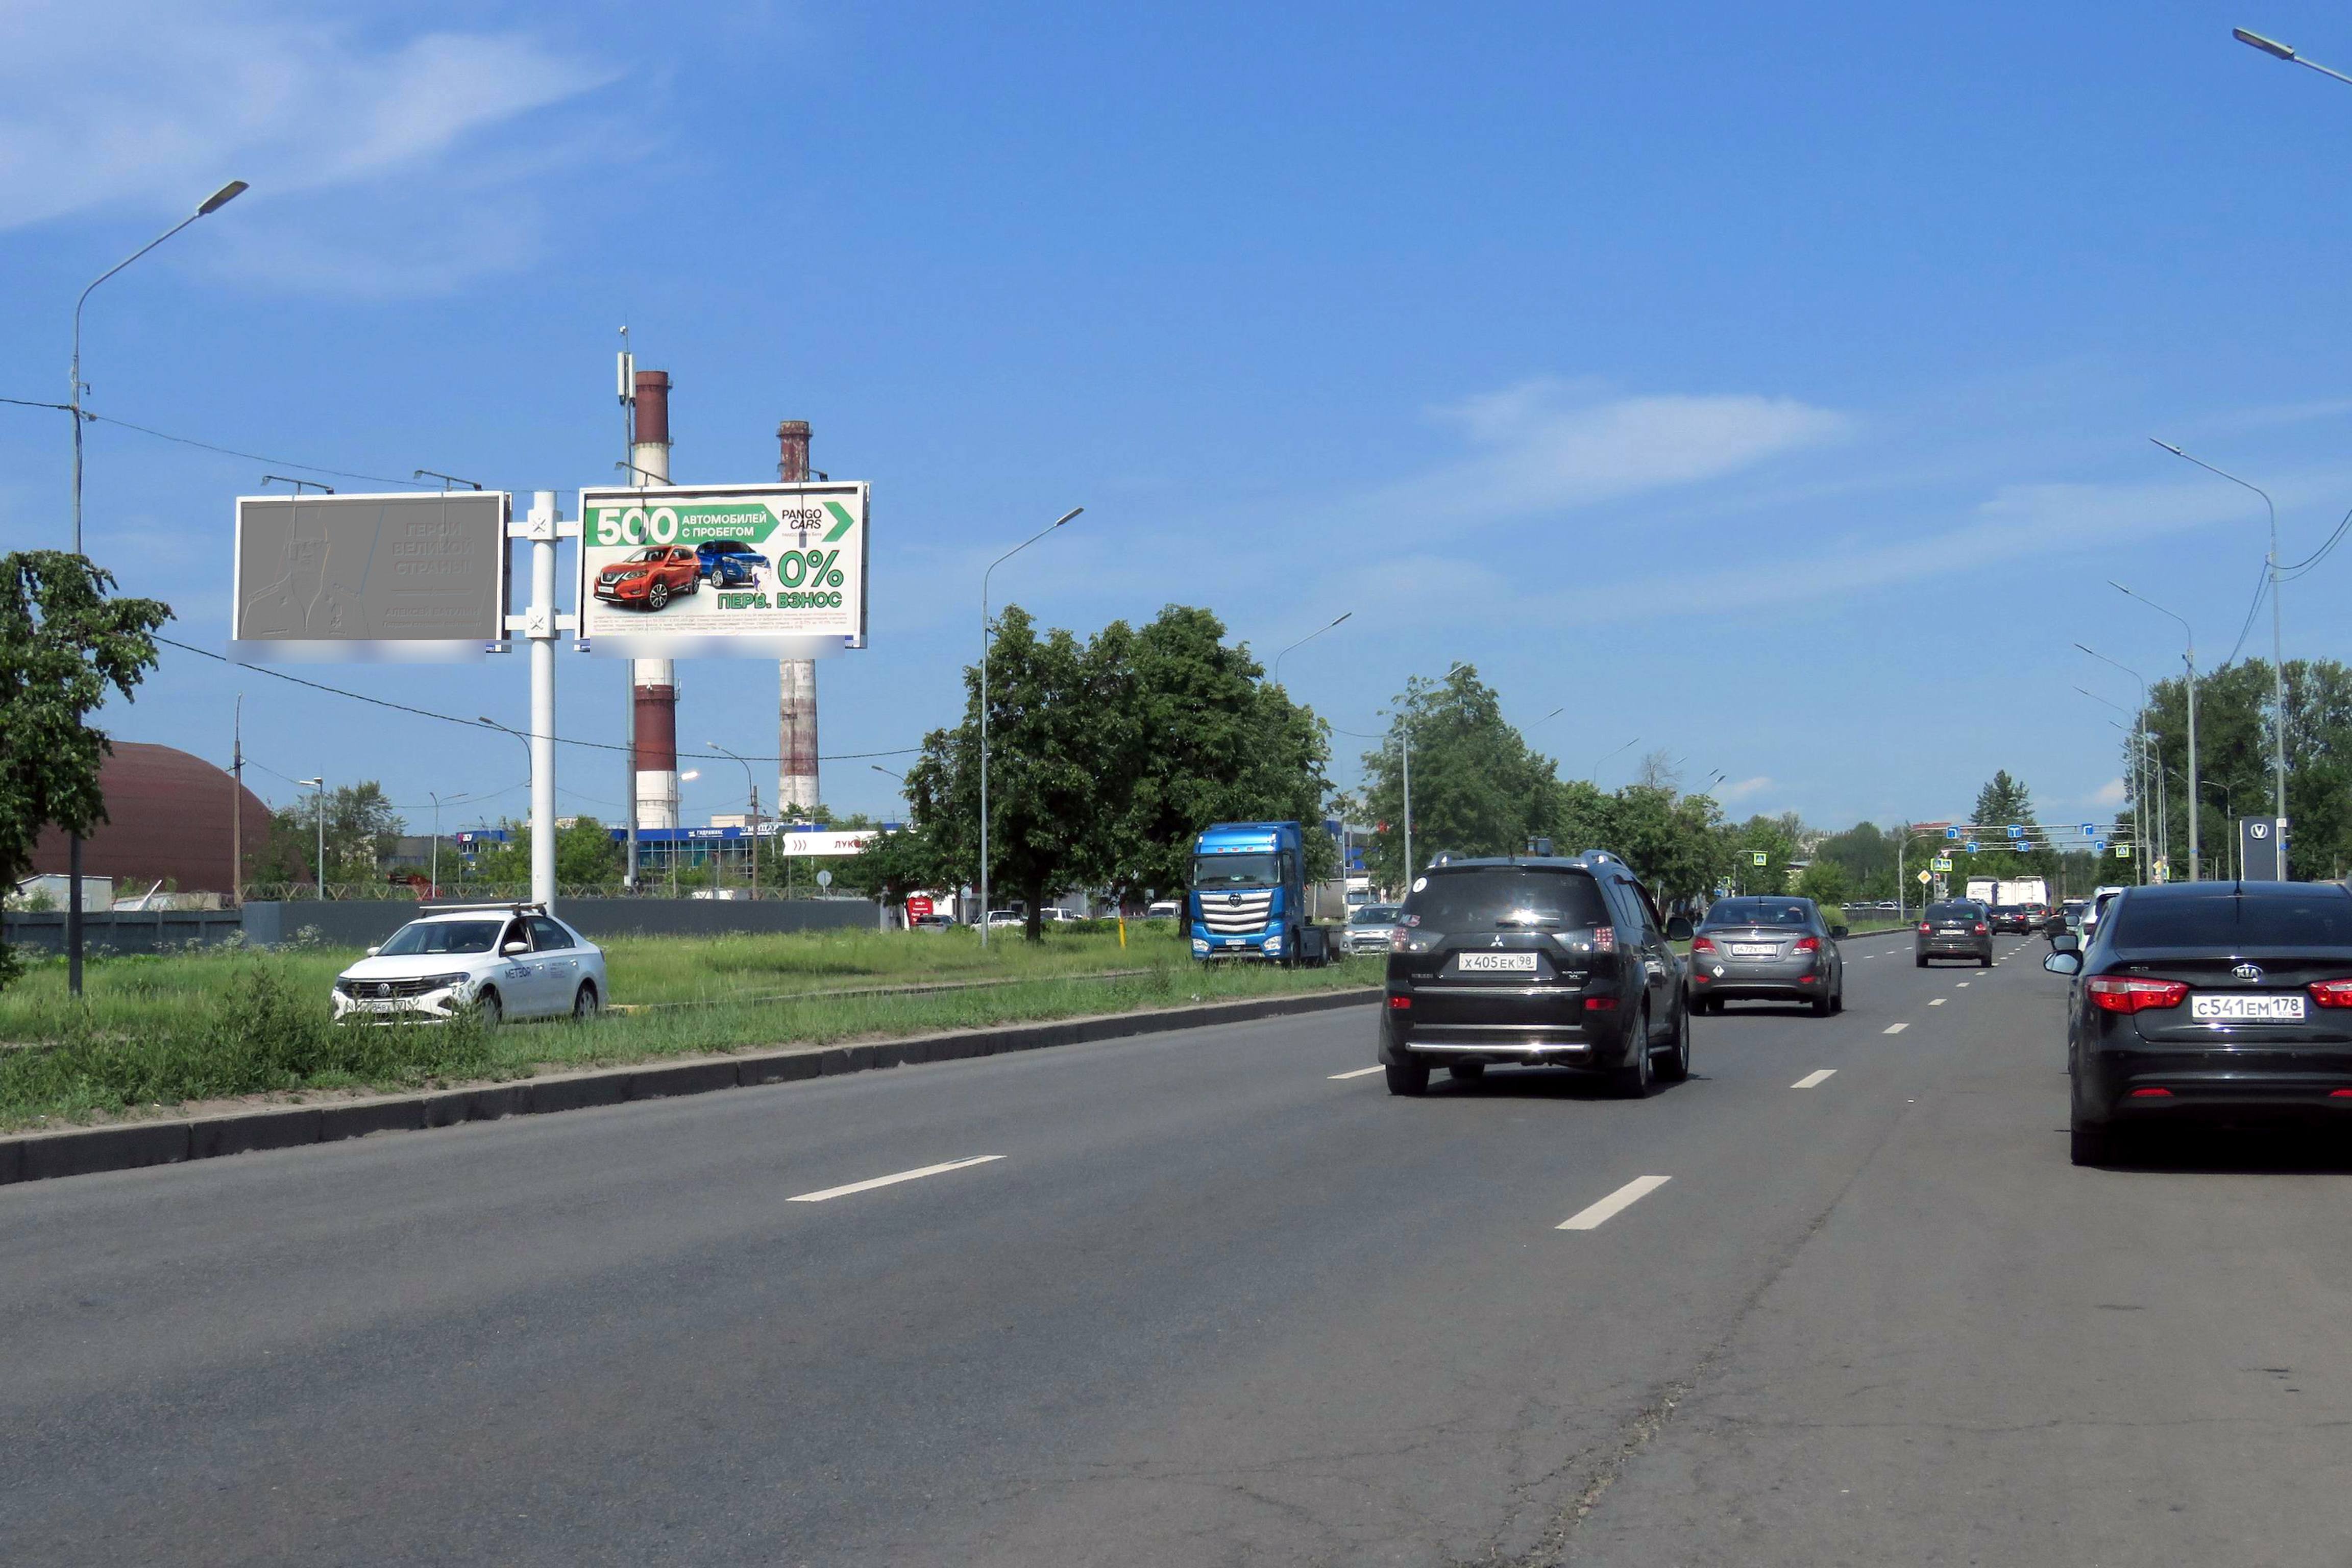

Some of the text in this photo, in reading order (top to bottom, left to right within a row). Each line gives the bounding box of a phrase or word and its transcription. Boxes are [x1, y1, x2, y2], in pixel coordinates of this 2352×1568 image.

[682, 511, 767, 525] АВТОМОБИЛЕЙ
[782, 509, 822, 519] PANGO
[597, 507, 678, 545] 500
[790, 520, 821, 529] CARS
[682, 527, 754, 537] С ПРОБЕГОМ
[778, 550, 844, 587] 0%
[718, 592, 842, 609] ПЕРВ. ВЗНОС
[2236, 968, 2259, 977] KIA
[2272, 999, 2298, 1011] 178
